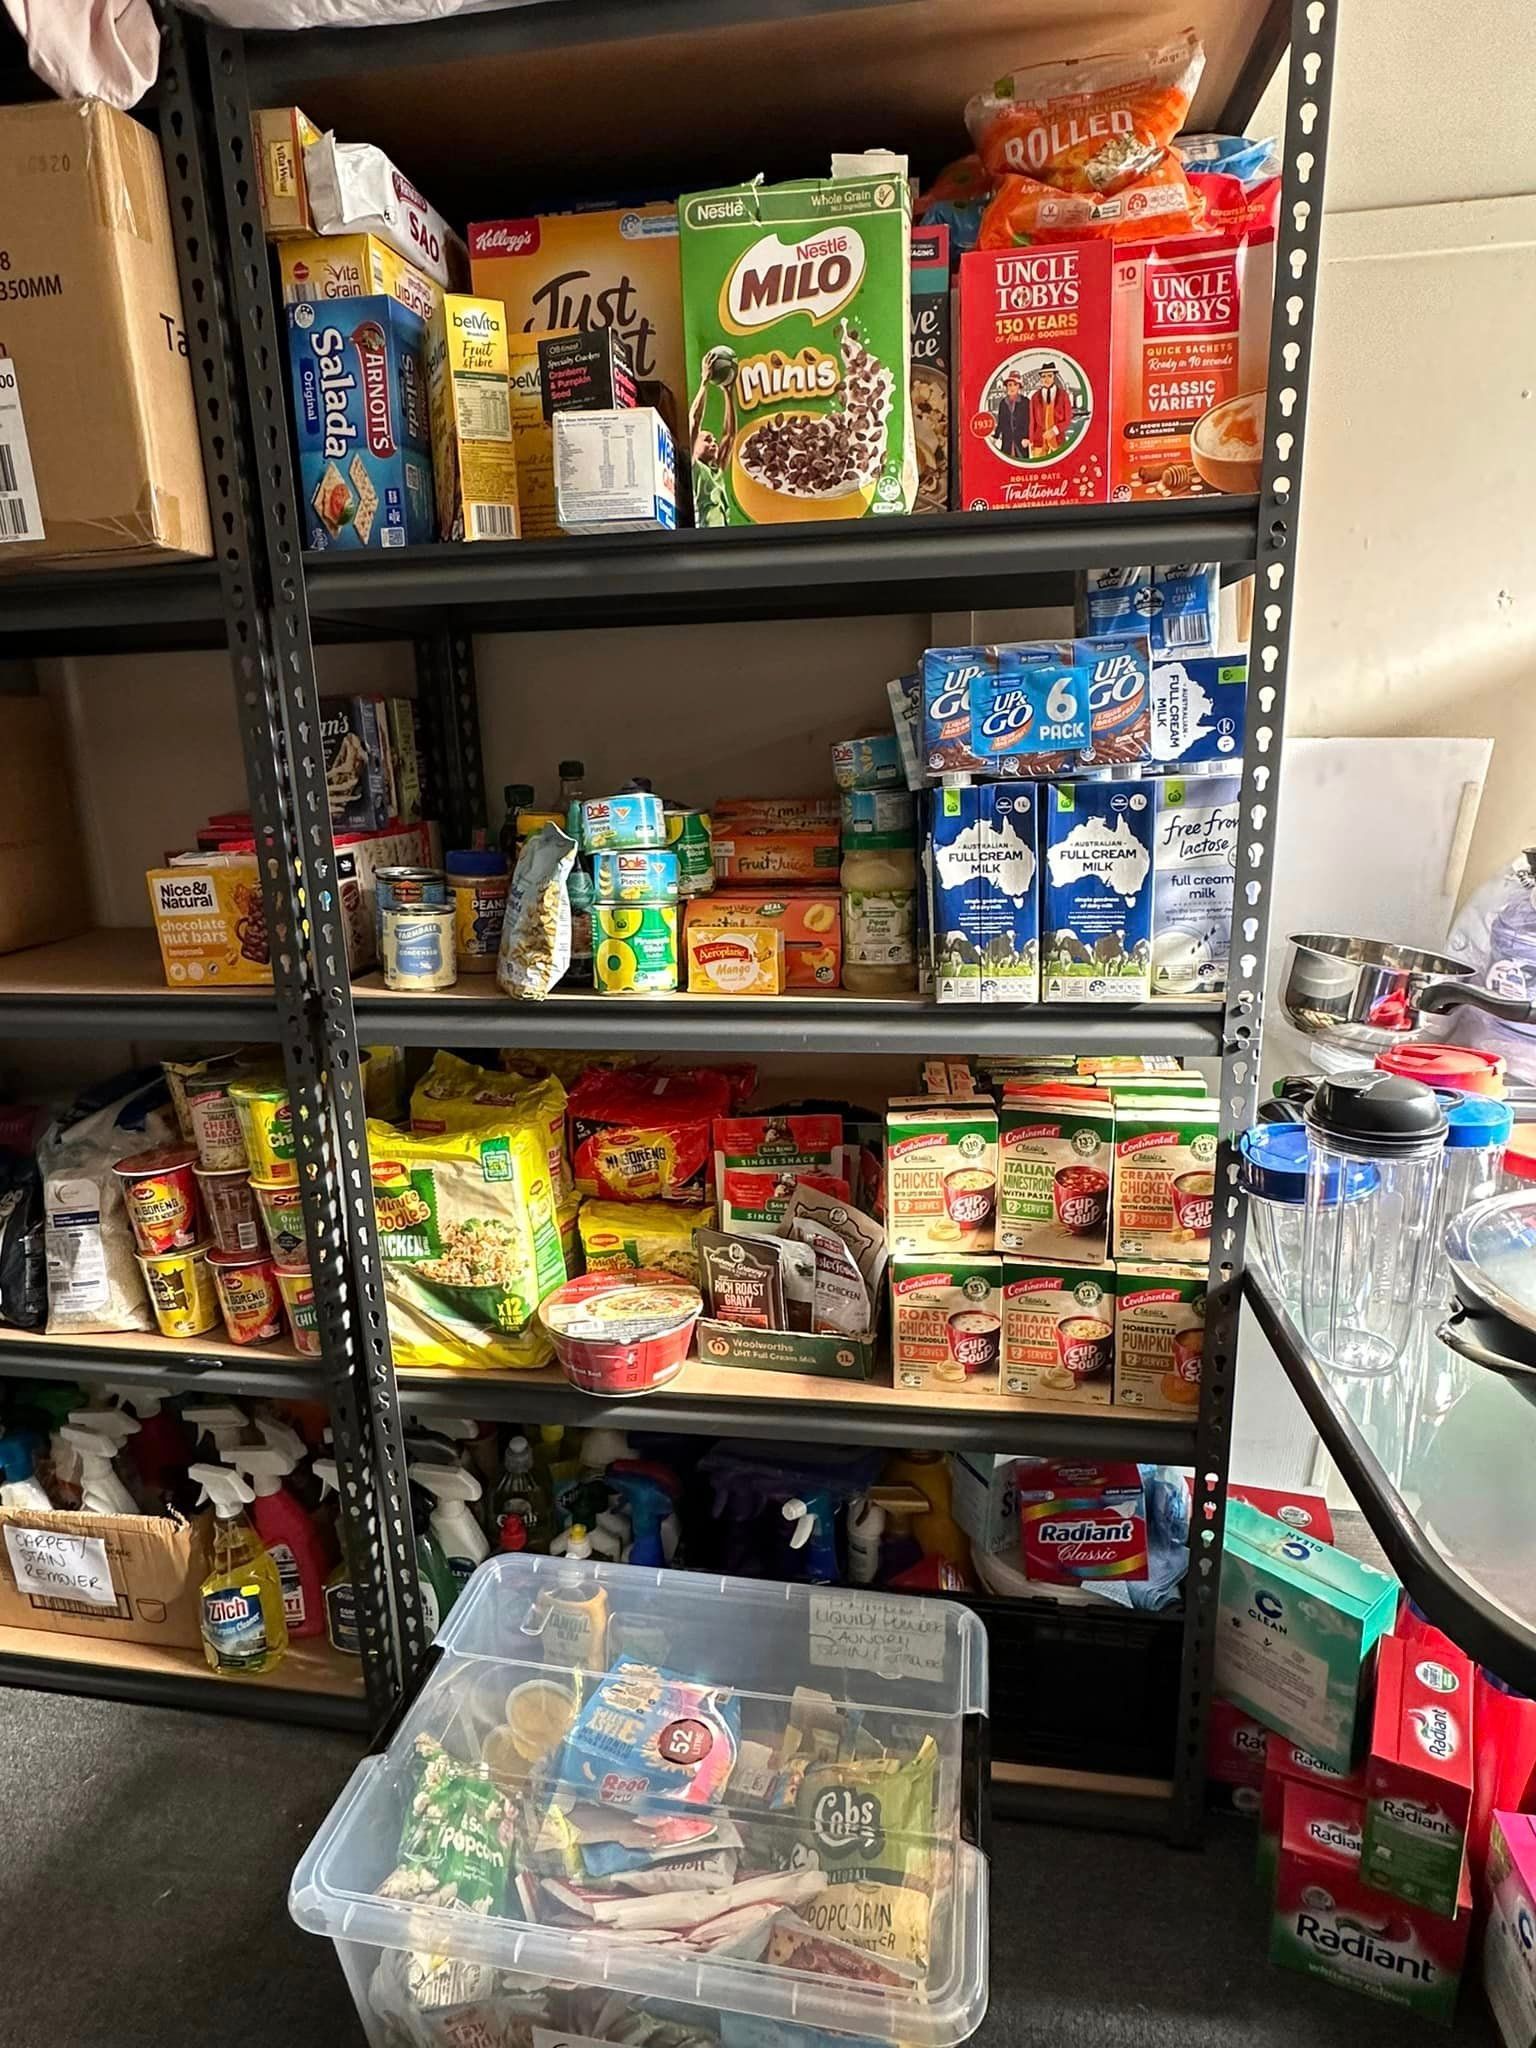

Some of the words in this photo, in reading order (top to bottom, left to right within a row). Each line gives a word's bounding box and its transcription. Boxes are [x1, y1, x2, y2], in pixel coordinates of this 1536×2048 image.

[1004, 110, 1134, 170] ROLLED
[811, 192, 842, 207] Whole
[844, 190, 872, 203] Grain
[697, 199, 743, 221] Nestlé
[409, 211, 439, 263] SAO
[476, 230, 530, 251] Kellogg's
[796, 236, 848, 262] Nestlé
[327, 263, 359, 281] Vita
[996, 256, 1078, 286] UNCLE
[1119, 266, 1137, 281] 10
[324, 282, 361, 298] Grain
[740, 254, 851, 313] MILO
[1152, 271, 1233, 299] UNCLE
[524, 270, 638, 332] Just
[996, 281, 1078, 311] TOBYS
[1152, 295, 1231, 324] TOBYS
[453, 311, 500, 333] belVita
[996, 318, 1024, 334] 130
[1028, 313, 1078, 331] YEARS
[462, 340, 497, 357] Fruit
[1147, 345, 1181, 357] QUICK
[1186, 342, 1233, 353] SACHETS
[1148, 358, 1177, 372] Ready
[740, 356, 837, 402] Minis
[303, 371, 317, 421] Original
[311, 327, 357, 460] Salada
[1149, 380, 1216, 397] CLASSIC
[365, 353, 390, 451] ARNOTT'S
[1149, 395, 1215, 412] VARIETY
[973, 420, 993, 430] 1932
[1000, 480, 1068, 503] Traditional
[1094, 655, 1137, 681] UP&
[1089, 671, 1145, 710] GO
[1169, 674, 1180, 704] FULL
[993, 690, 1028, 711] UP&
[1046, 677, 1078, 722] 6
[982, 703, 1034, 735] GO
[1157, 697, 1168, 727] MILK
[1040, 722, 1086, 740] PACK
[1169, 705, 1180, 748] CREAM
[587, 803, 610, 817] Dole
[1163, 815, 1203, 846] free
[962, 842, 1009, 850] AUSTRALIAN
[1060, 850, 1090, 860] FULL
[1091, 849, 1137, 860] CREAM
[1179, 838, 1230, 858] lactose
[618, 857, 647, 869] Dole
[738, 851, 770, 872] Fruit
[775, 857, 808, 873] Juice
[948, 852, 977, 862] FULL
[979, 850, 1023, 861] CREAM
[970, 863, 1001, 874] MILK
[1083, 861, 1113, 871] MILK
[620, 877, 647, 886] Pieces
[1171, 874, 1192, 887] full
[1194, 876, 1235, 886] cream
[161, 894, 213, 909] Natural
[1189, 888, 1216, 899] milk
[161, 918, 227, 932] chocolate
[866, 925, 891, 934] Slices
[868, 919, 888, 928] Pear
[163, 932, 189, 945] nut
[191, 930, 228, 943] bars
[698, 946, 748, 962] Aeroplane
[716, 962, 751, 976] Mango
[576, 1121, 584, 1132] 5
[1004, 1127, 1058, 1144] Continental
[1120, 1134, 1176, 1154] Continental
[894, 1136, 943, 1157] Continental
[621, 1147, 666, 1165] GORENG
[741, 1156, 777, 1167] SINGLE
[783, 1155, 816, 1164] SNACK
[1004, 1161, 1056, 1176] ITALIAN
[1120, 1170, 1173, 1181] CREAMY
[894, 1171, 943, 1190] CHICKEN
[1004, 1174, 1055, 1193] MINESTRONE
[1120, 1181, 1173, 1195] CHICKEN
[375, 1190, 418, 1213] Minute
[1004, 1190, 1025, 1198] WITH
[1027, 1191, 1053, 1200] PASTA
[1022, 1203, 1049, 1214] SERVES
[1141, 1214, 1168, 1225] SERVES
[714, 1280, 733, 1294] RICH
[735, 1283, 764, 1297] ROAST
[827, 1282, 860, 1301] CHICKEN
[899, 1276, 949, 1292] Continental
[1007, 1280, 1060, 1297] Continental
[724, 1294, 753, 1308] GRAVY
[1122, 1292, 1179, 1308] Continental
[899, 1310, 949, 1322] ROAST
[1007, 1312, 1058, 1325] CREAMY
[899, 1322, 948, 1337] CHICKEN
[1007, 1323, 1057, 1340] CHICKEN
[1122, 1323, 1177, 1335] HOMESTYLE
[732, 1338, 794, 1353] Woolworths
[1122, 1333, 1174, 1350] PUMPKIN
[733, 1349, 751, 1359] UHT
[753, 1350, 768, 1360] Full
[770, 1352, 799, 1363] Cream
[839, 1353, 853, 1364] 1L
[1026, 1350, 1053, 1361] SERVES
[1040, 1521, 1132, 1543] Radiant
[1286, 1531, 1324, 1553] CLEAN
[20, 1549, 66, 1568] STAIN
[1056, 1542, 1117, 1562] Classic
[25, 1563, 103, 1591] REMOVER
[207, 1598, 249, 1622] Zilch
[1248, 1608, 1288, 1636] CLEAN
[1429, 1708, 1447, 1758] Radiant
[670, 1729, 693, 1755] 52
[814, 1790, 875, 1848] Cobs
[1384, 1799, 1452, 1835] Radiant
[1296, 1913, 1437, 1983] Radiant
